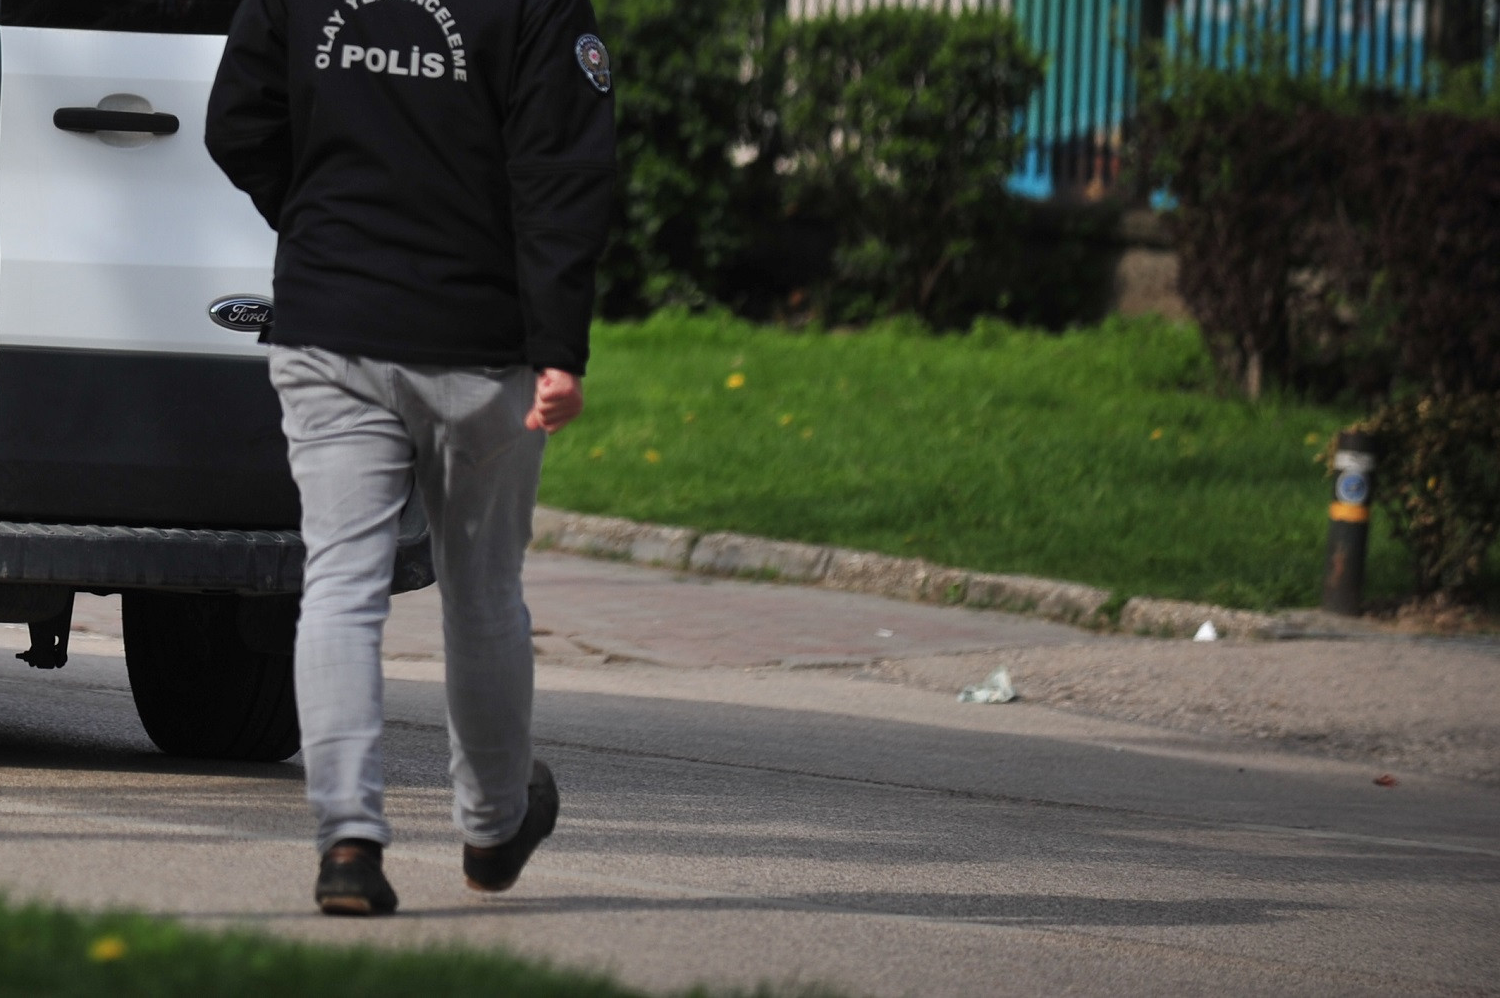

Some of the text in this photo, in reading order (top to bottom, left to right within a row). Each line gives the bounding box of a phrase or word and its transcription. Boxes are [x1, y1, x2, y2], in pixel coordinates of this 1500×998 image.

[315, 9, 346, 70] OLAY
[341, 45, 446, 79] POLİS
[228, 304, 269, 322] Ford
